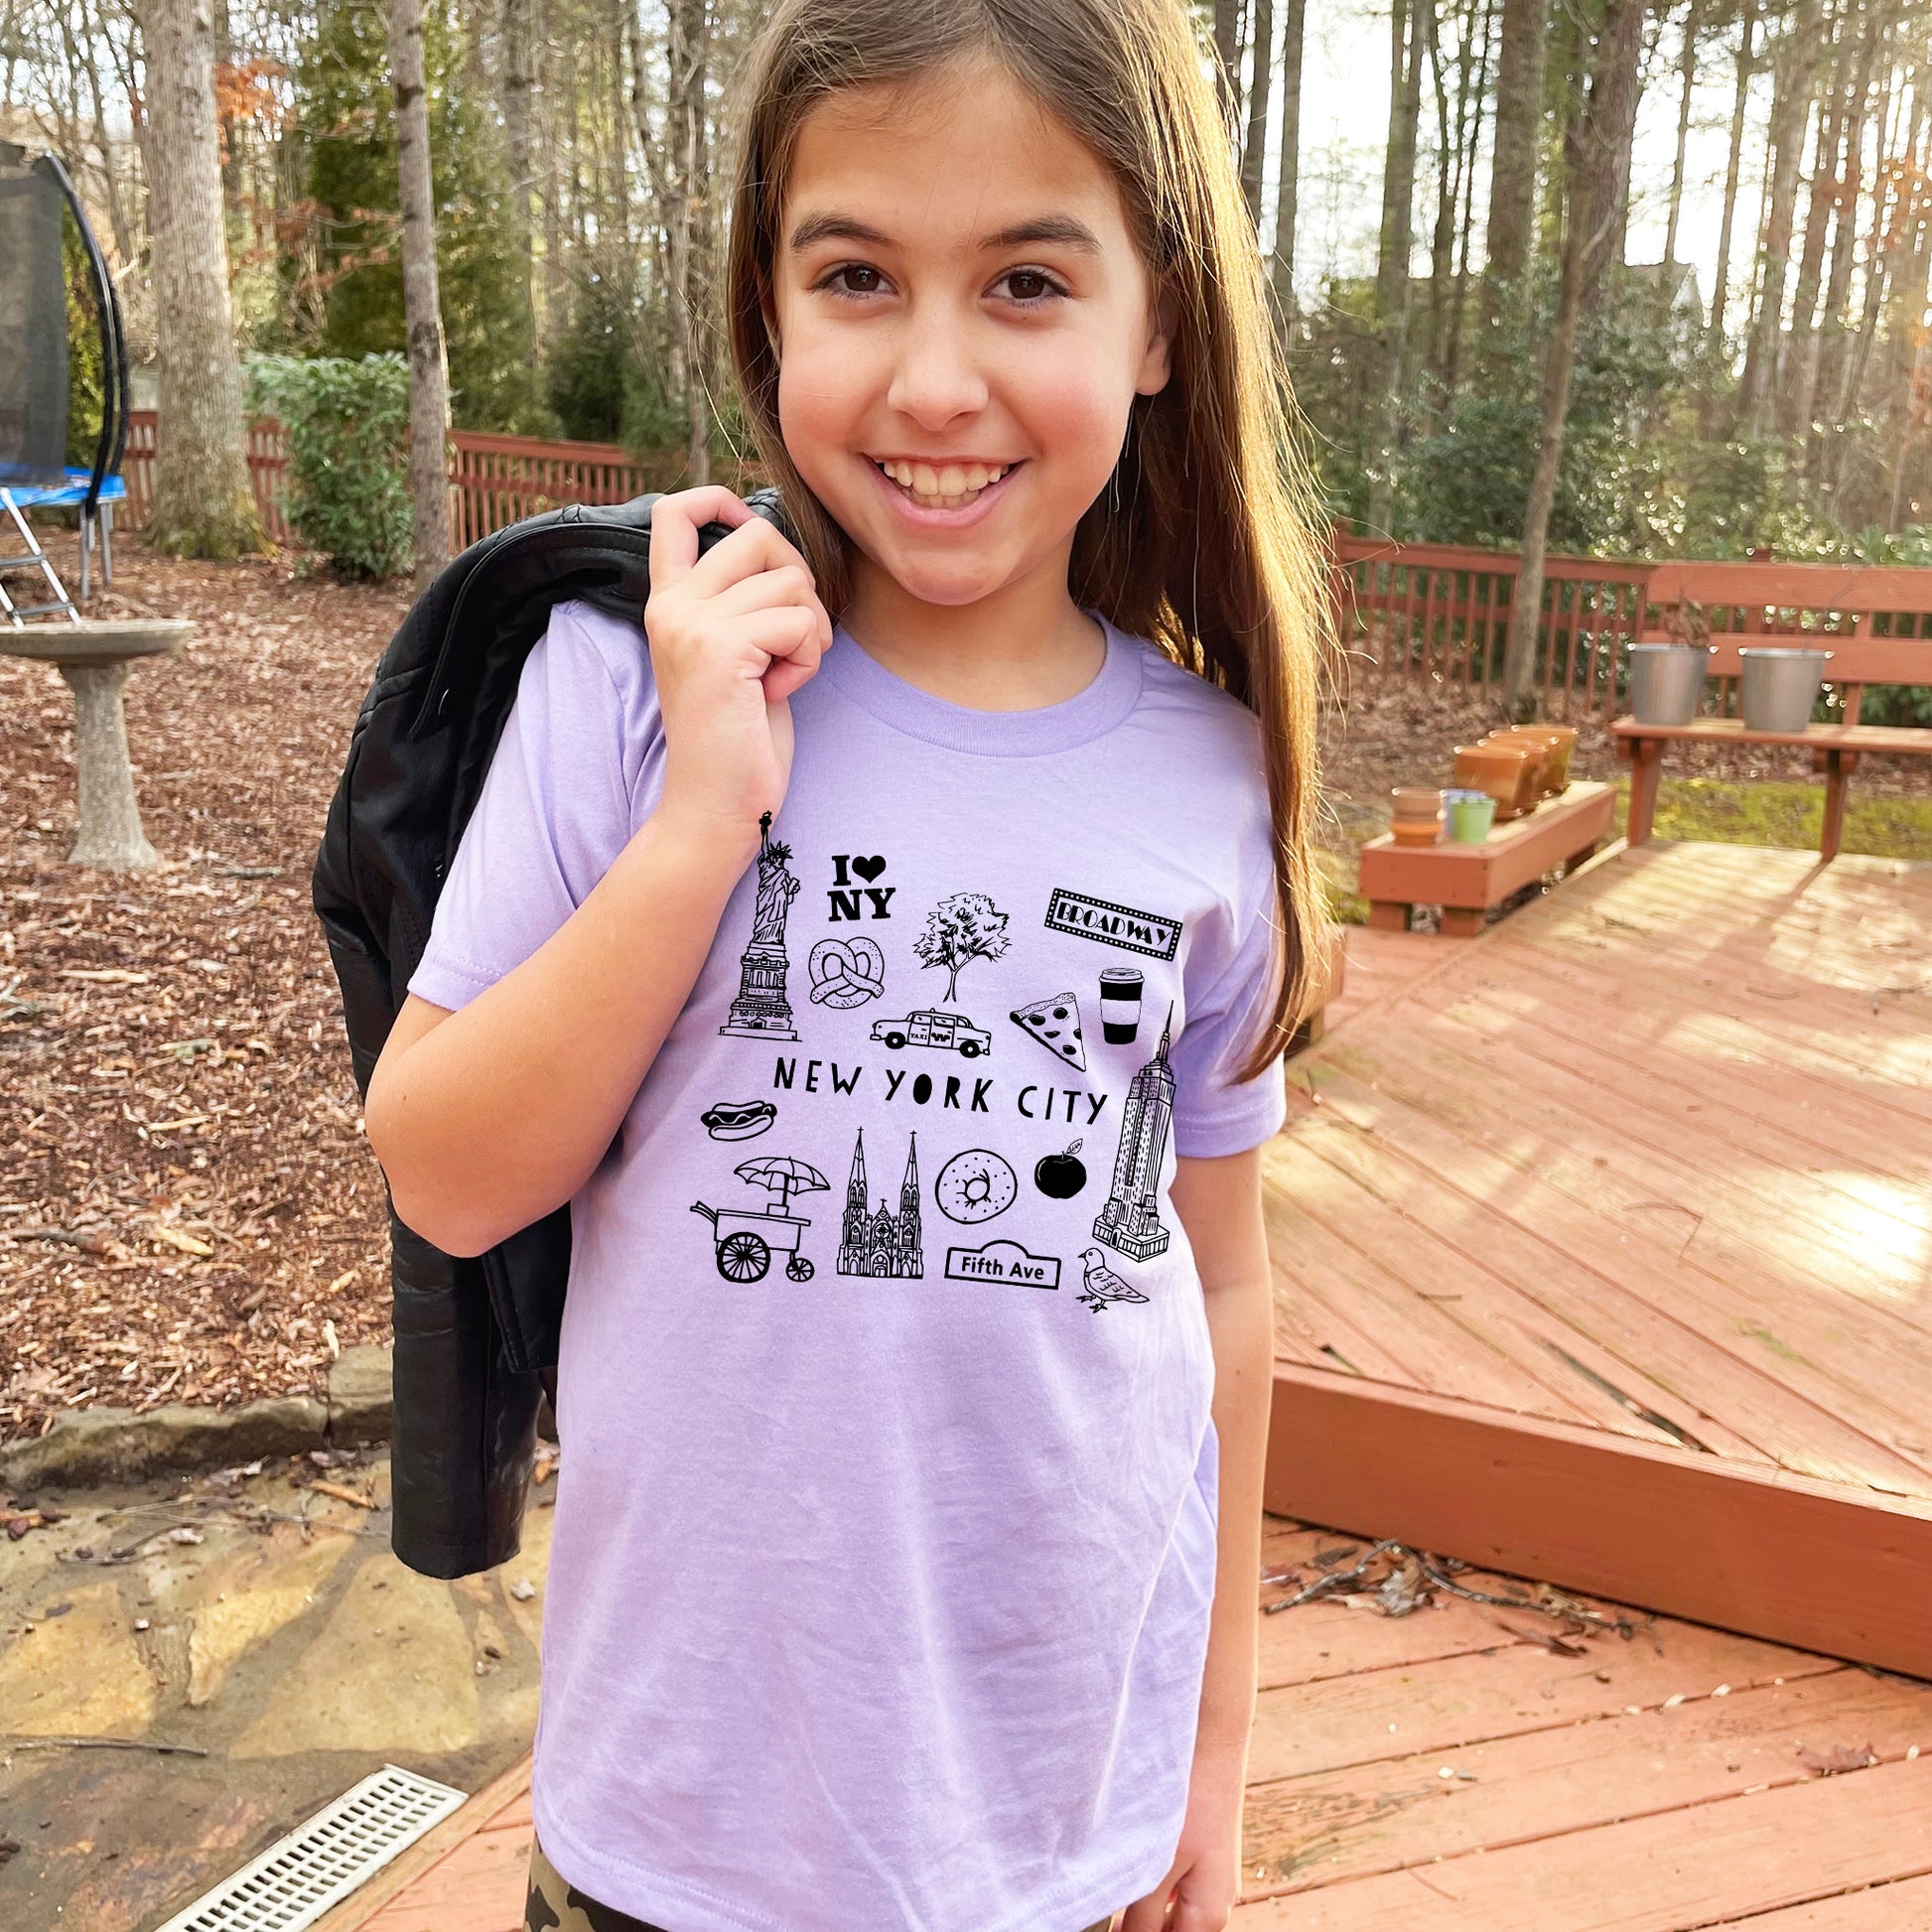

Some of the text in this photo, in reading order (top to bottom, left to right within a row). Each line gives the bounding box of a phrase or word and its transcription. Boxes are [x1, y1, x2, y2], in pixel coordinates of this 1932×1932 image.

[832, 855, 851, 886] I
[827, 888, 896, 921] NY
[1056, 901, 1172, 946] BROADWAY
[773, 1056, 1108, 1125] NEW YORK CITY
[961, 1256, 1044, 1280] Fifth Ave
